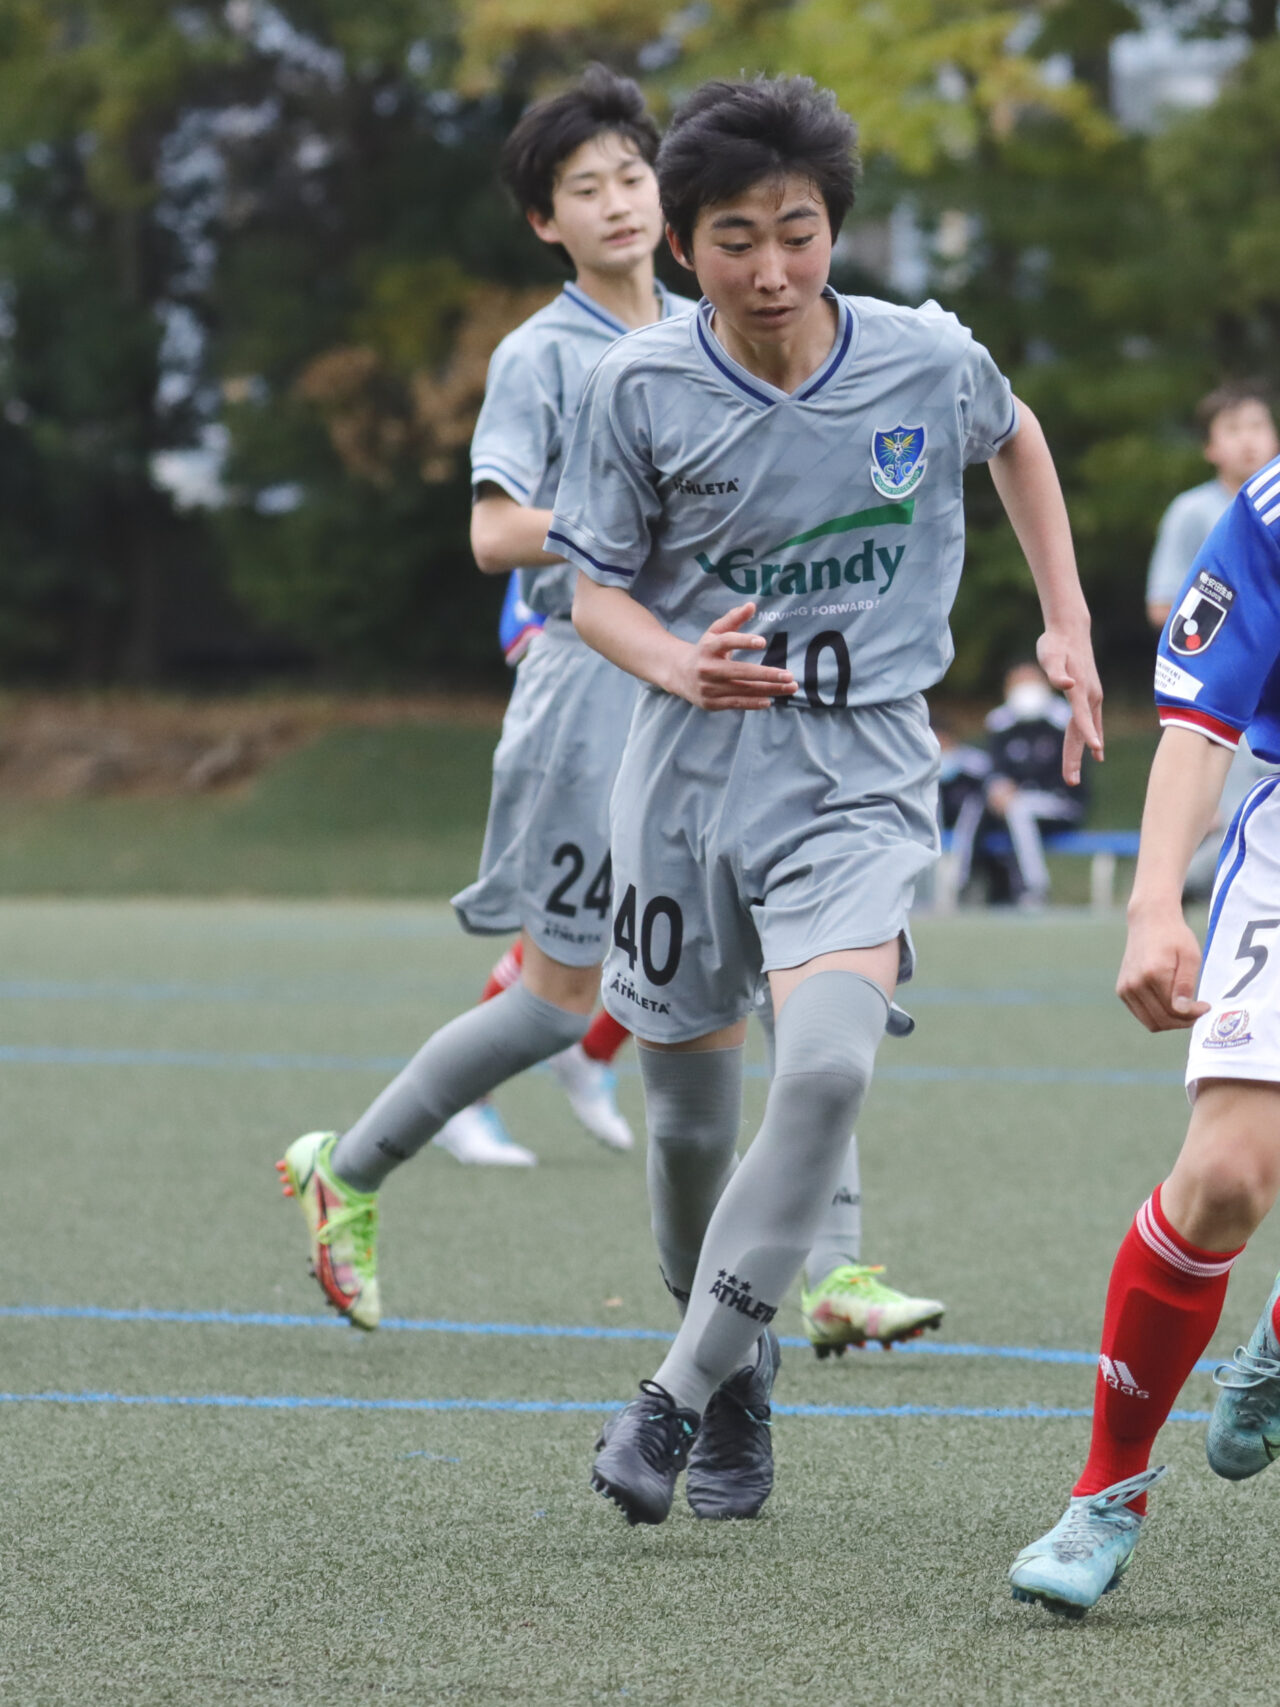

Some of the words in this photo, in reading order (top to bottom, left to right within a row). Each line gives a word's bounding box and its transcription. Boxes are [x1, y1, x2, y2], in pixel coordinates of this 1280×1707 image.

[694, 538, 906, 597] Grandy
[757, 606, 808, 622] MOVING
[811, 599, 882, 616] FORWARD!
[545, 841, 613, 921] 24
[613, 883, 684, 987] 40
[610, 979, 671, 1015] ATHLETA
